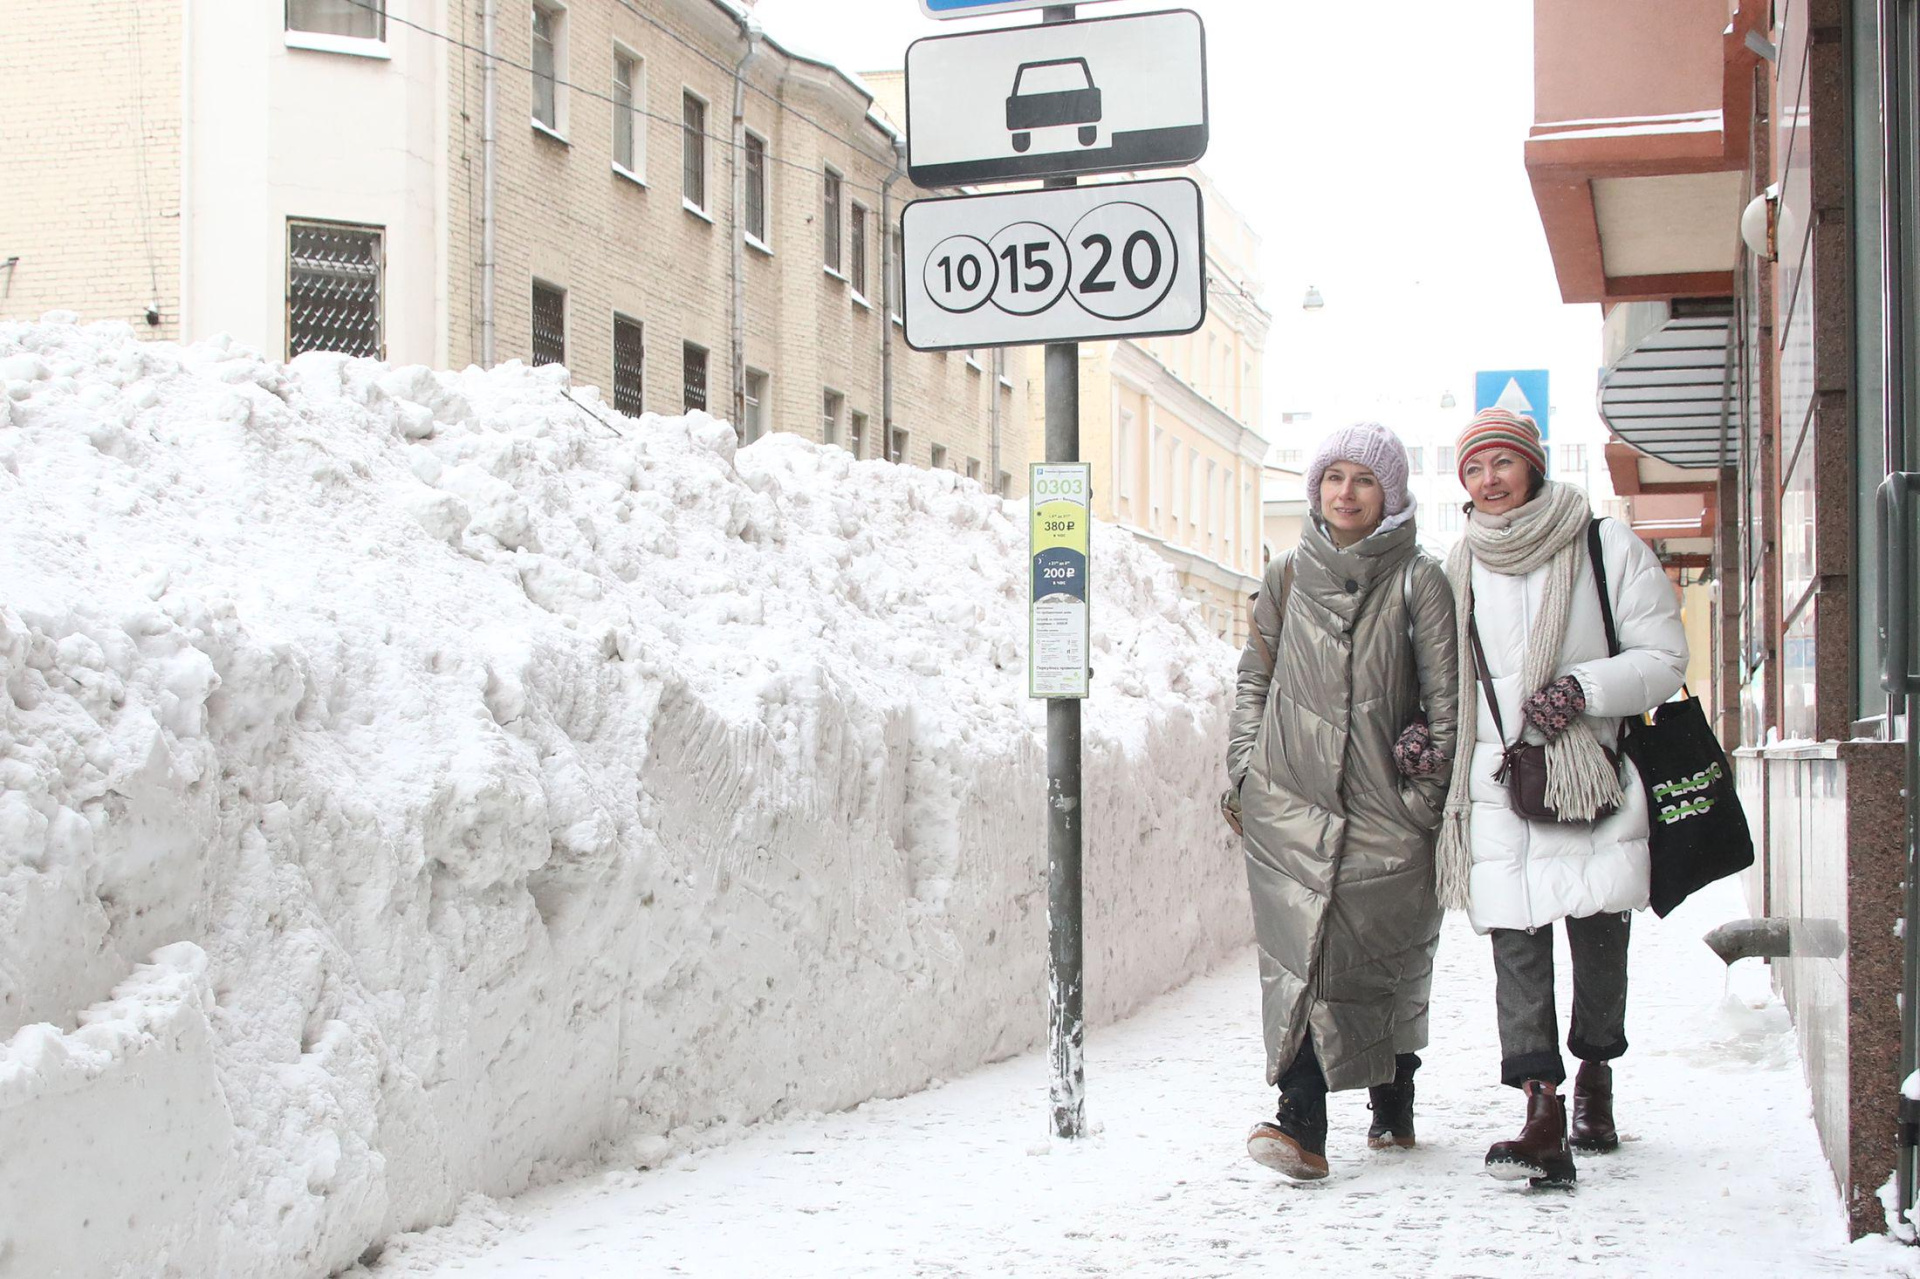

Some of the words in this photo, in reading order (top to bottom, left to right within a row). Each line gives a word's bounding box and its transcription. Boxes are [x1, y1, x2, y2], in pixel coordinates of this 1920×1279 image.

[937, 254, 982, 293] 10
[1000, 241, 1053, 293] 15
[1079, 230, 1162, 294] 20
[1037, 479, 1082, 494] 0303
[1652, 761, 1723, 803] PLASTC
[1660, 796, 1711, 825] BAG
